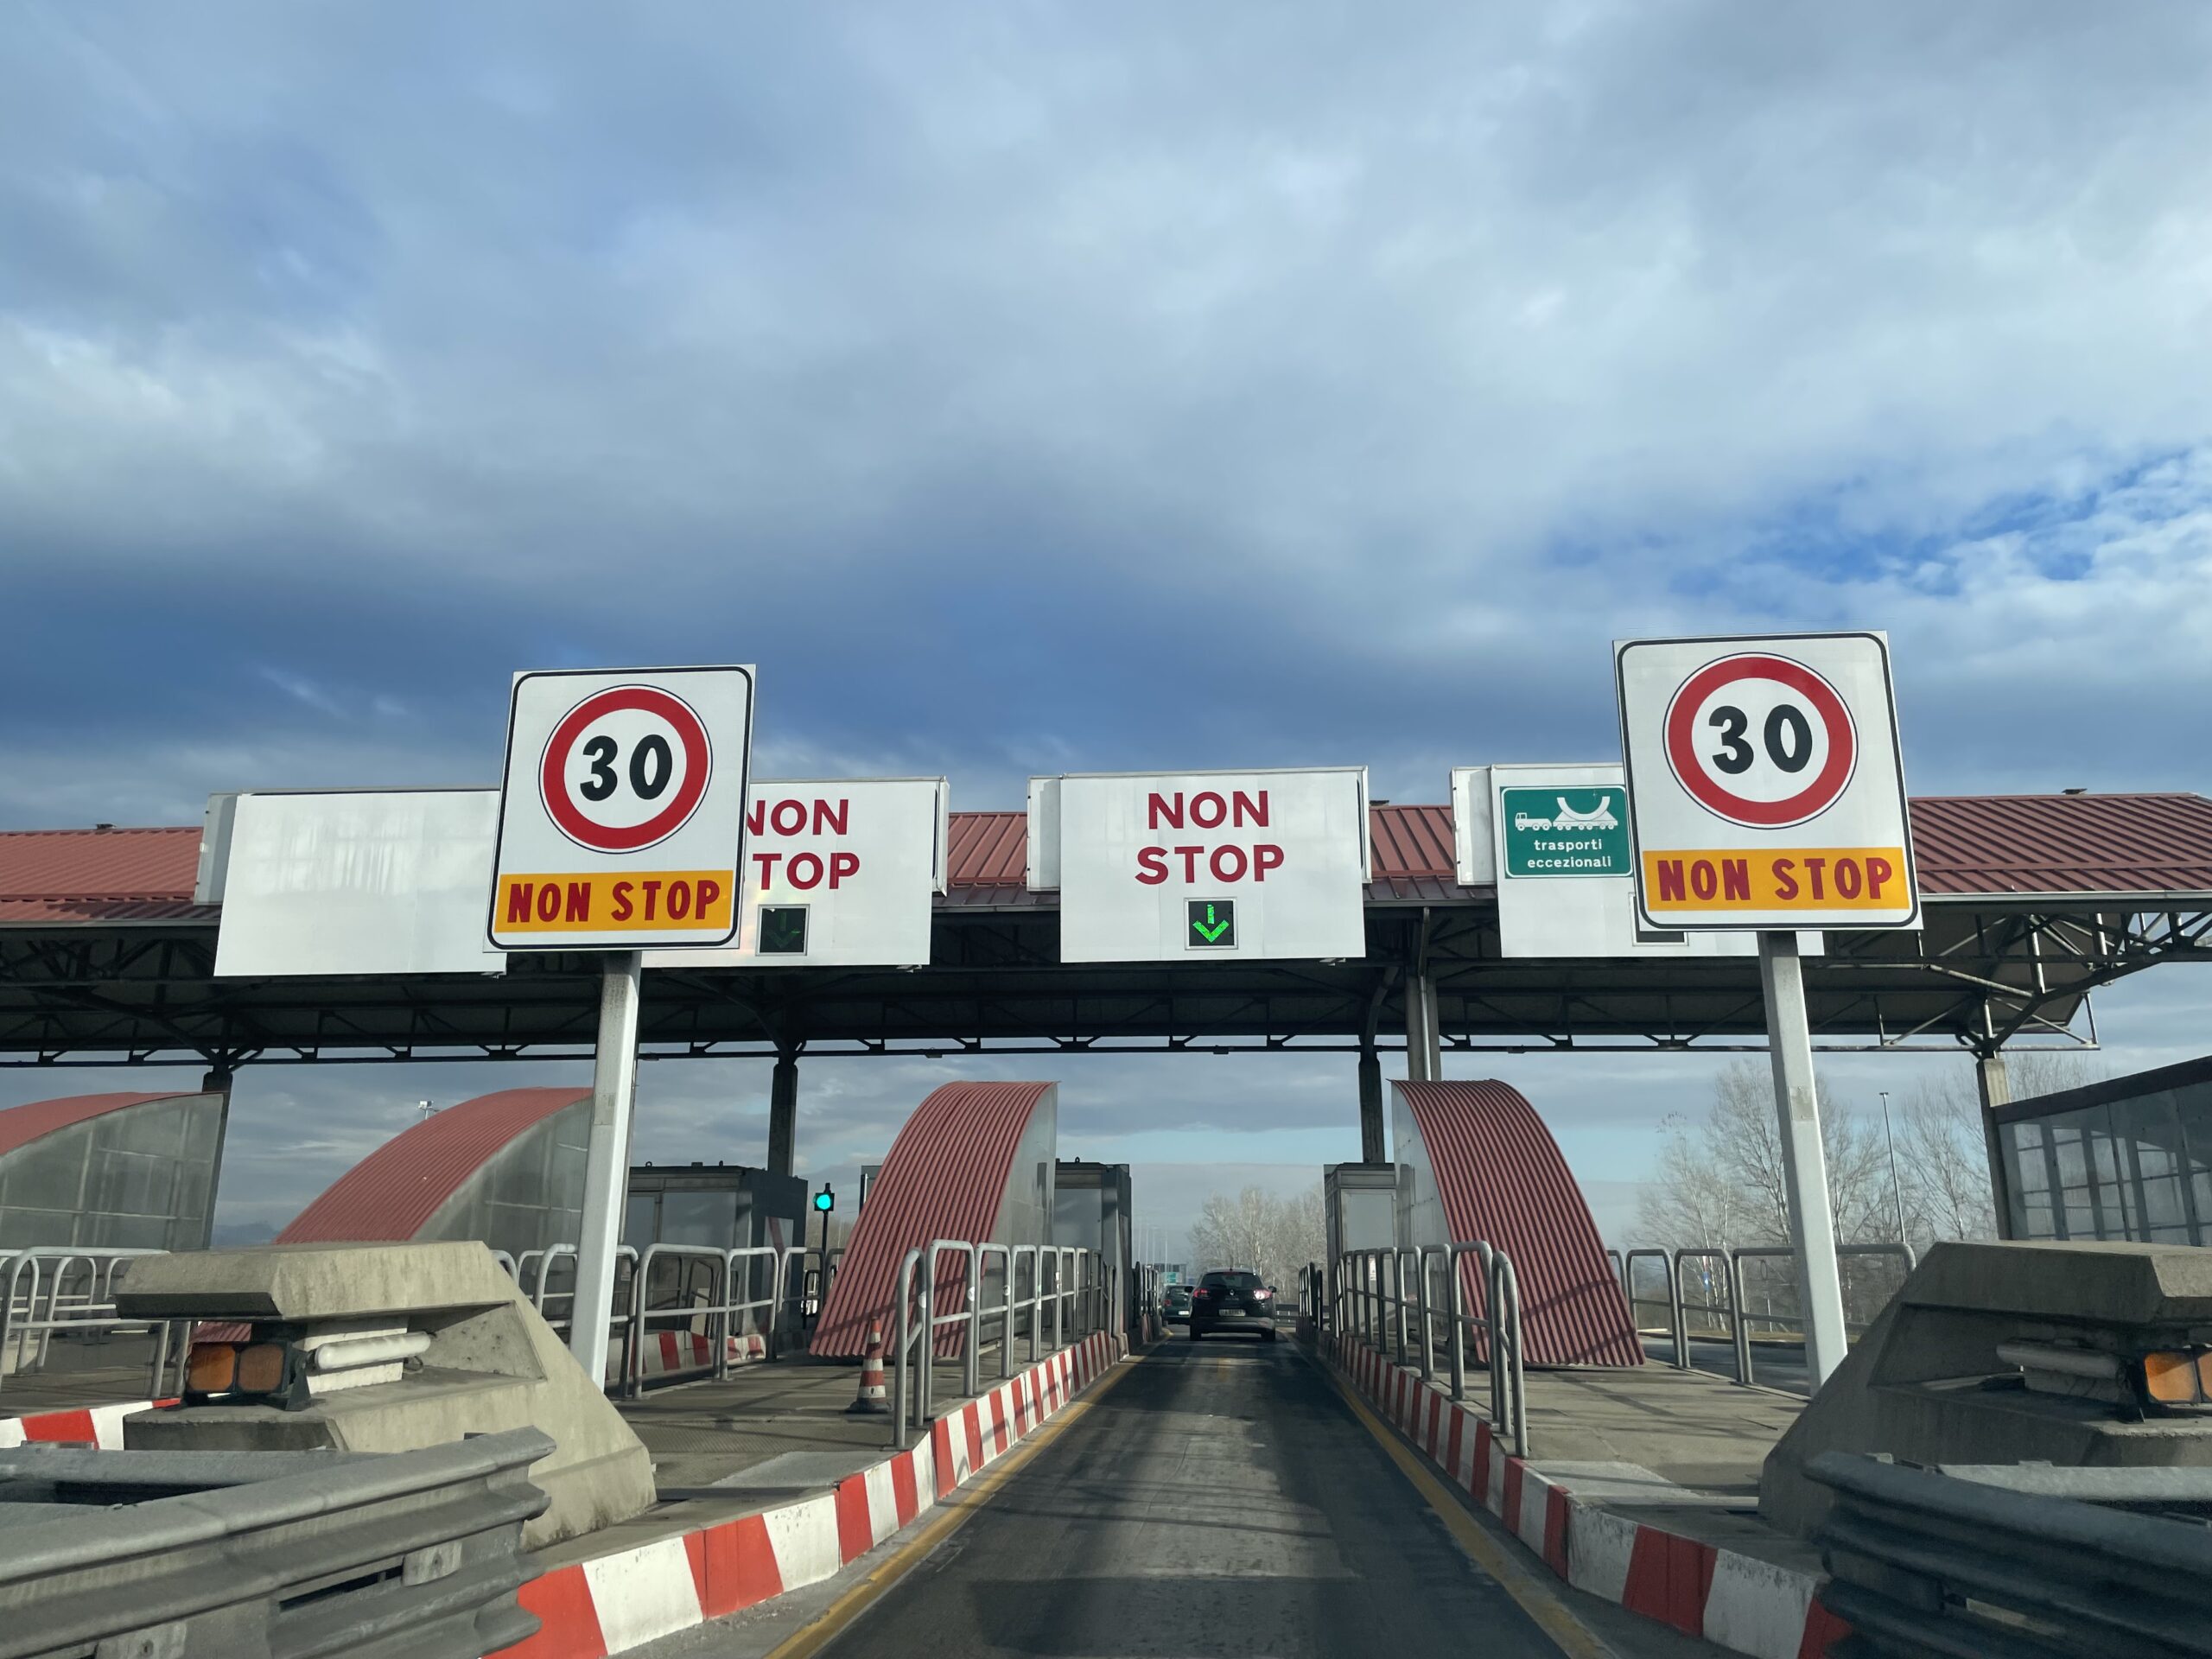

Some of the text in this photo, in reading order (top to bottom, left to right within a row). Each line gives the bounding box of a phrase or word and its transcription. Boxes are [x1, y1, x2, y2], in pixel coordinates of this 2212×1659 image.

[1708, 704, 1813, 774] 30
[580, 734, 673, 802] 30
[1148, 791, 1269, 830] NON
[1135, 844, 1284, 885] STOP
[1527, 855, 1611, 868] eccezionali
[1534, 838, 1602, 853] trasporti
[752, 852, 860, 890] TOP
[1657, 857, 1892, 901] NON STOP
[507, 880, 721, 924] NON STOP
